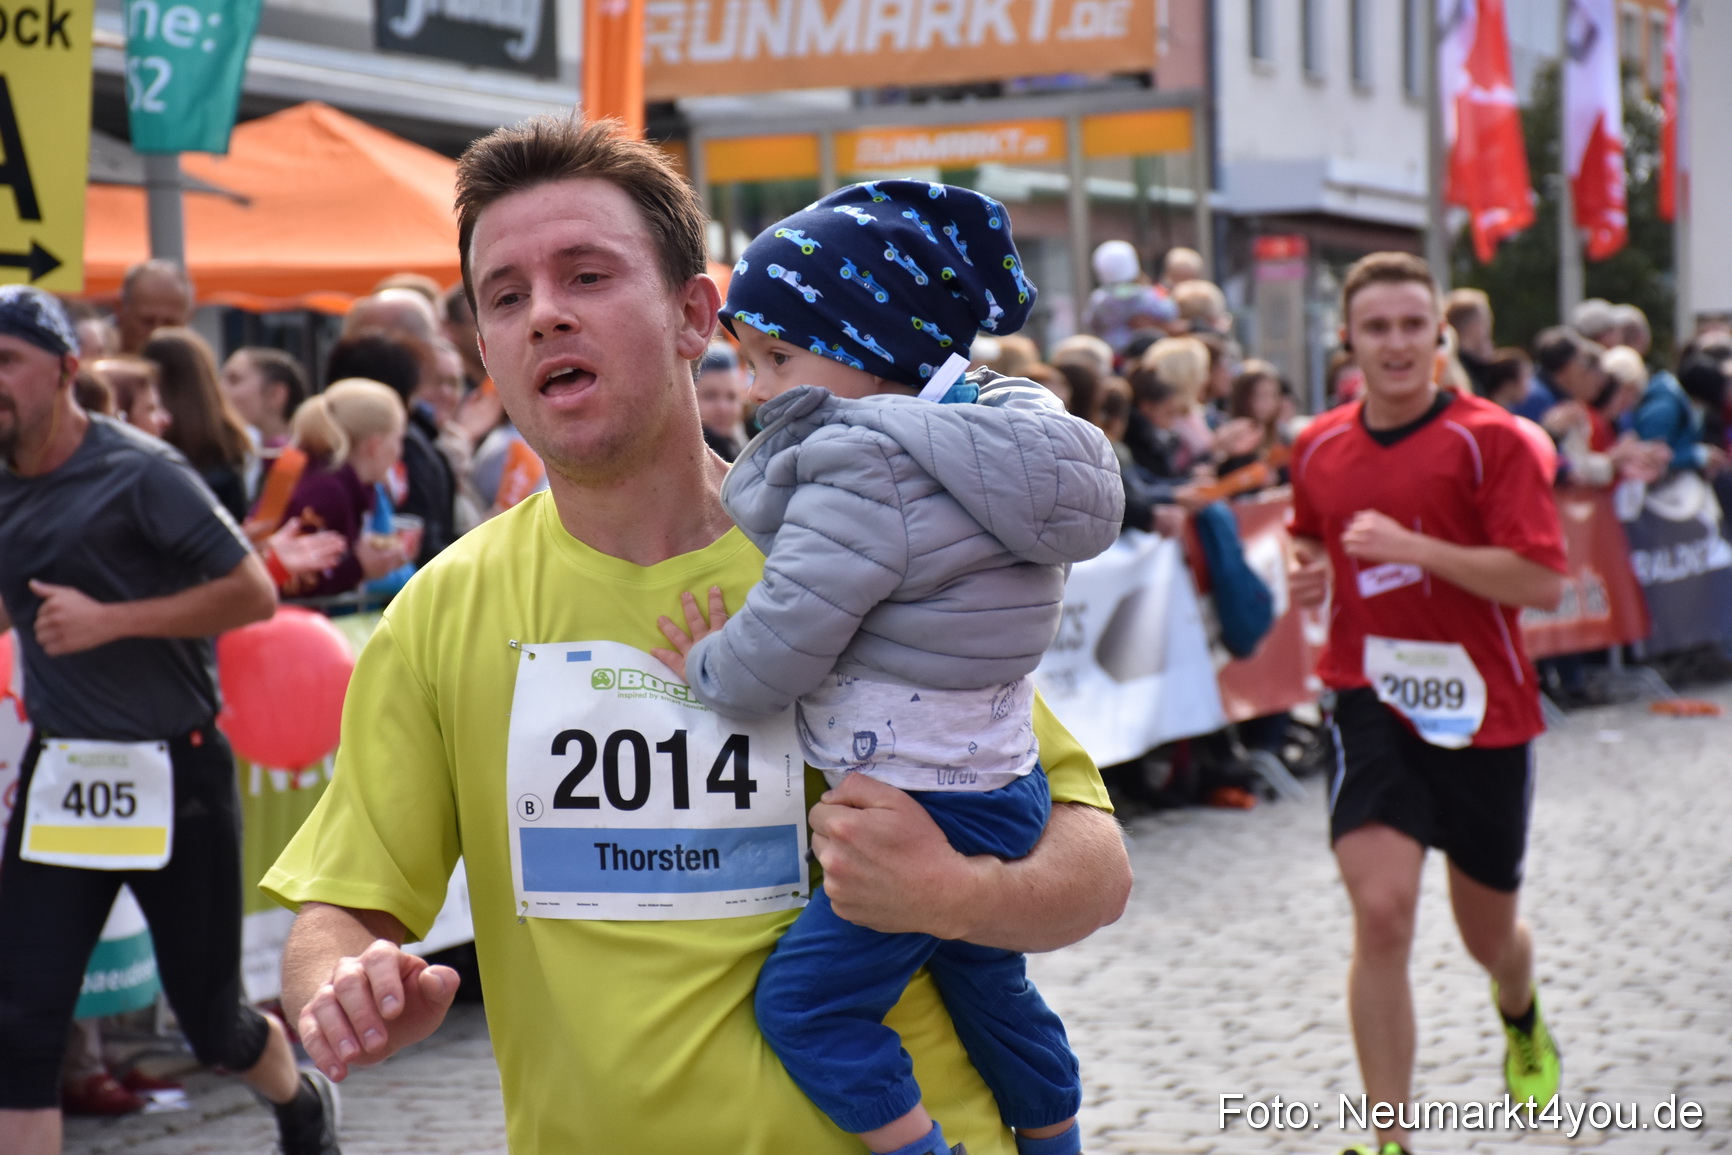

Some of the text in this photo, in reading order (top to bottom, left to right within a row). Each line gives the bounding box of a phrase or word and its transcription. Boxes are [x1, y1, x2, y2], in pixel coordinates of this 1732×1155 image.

[618, 691, 647, 699] inspired
[649, 692, 659, 700] by
[551, 729, 757, 811] 2014
[62, 782, 137, 819] 405
[525, 801, 535, 815] B
[594, 843, 720, 871] Thorsten
